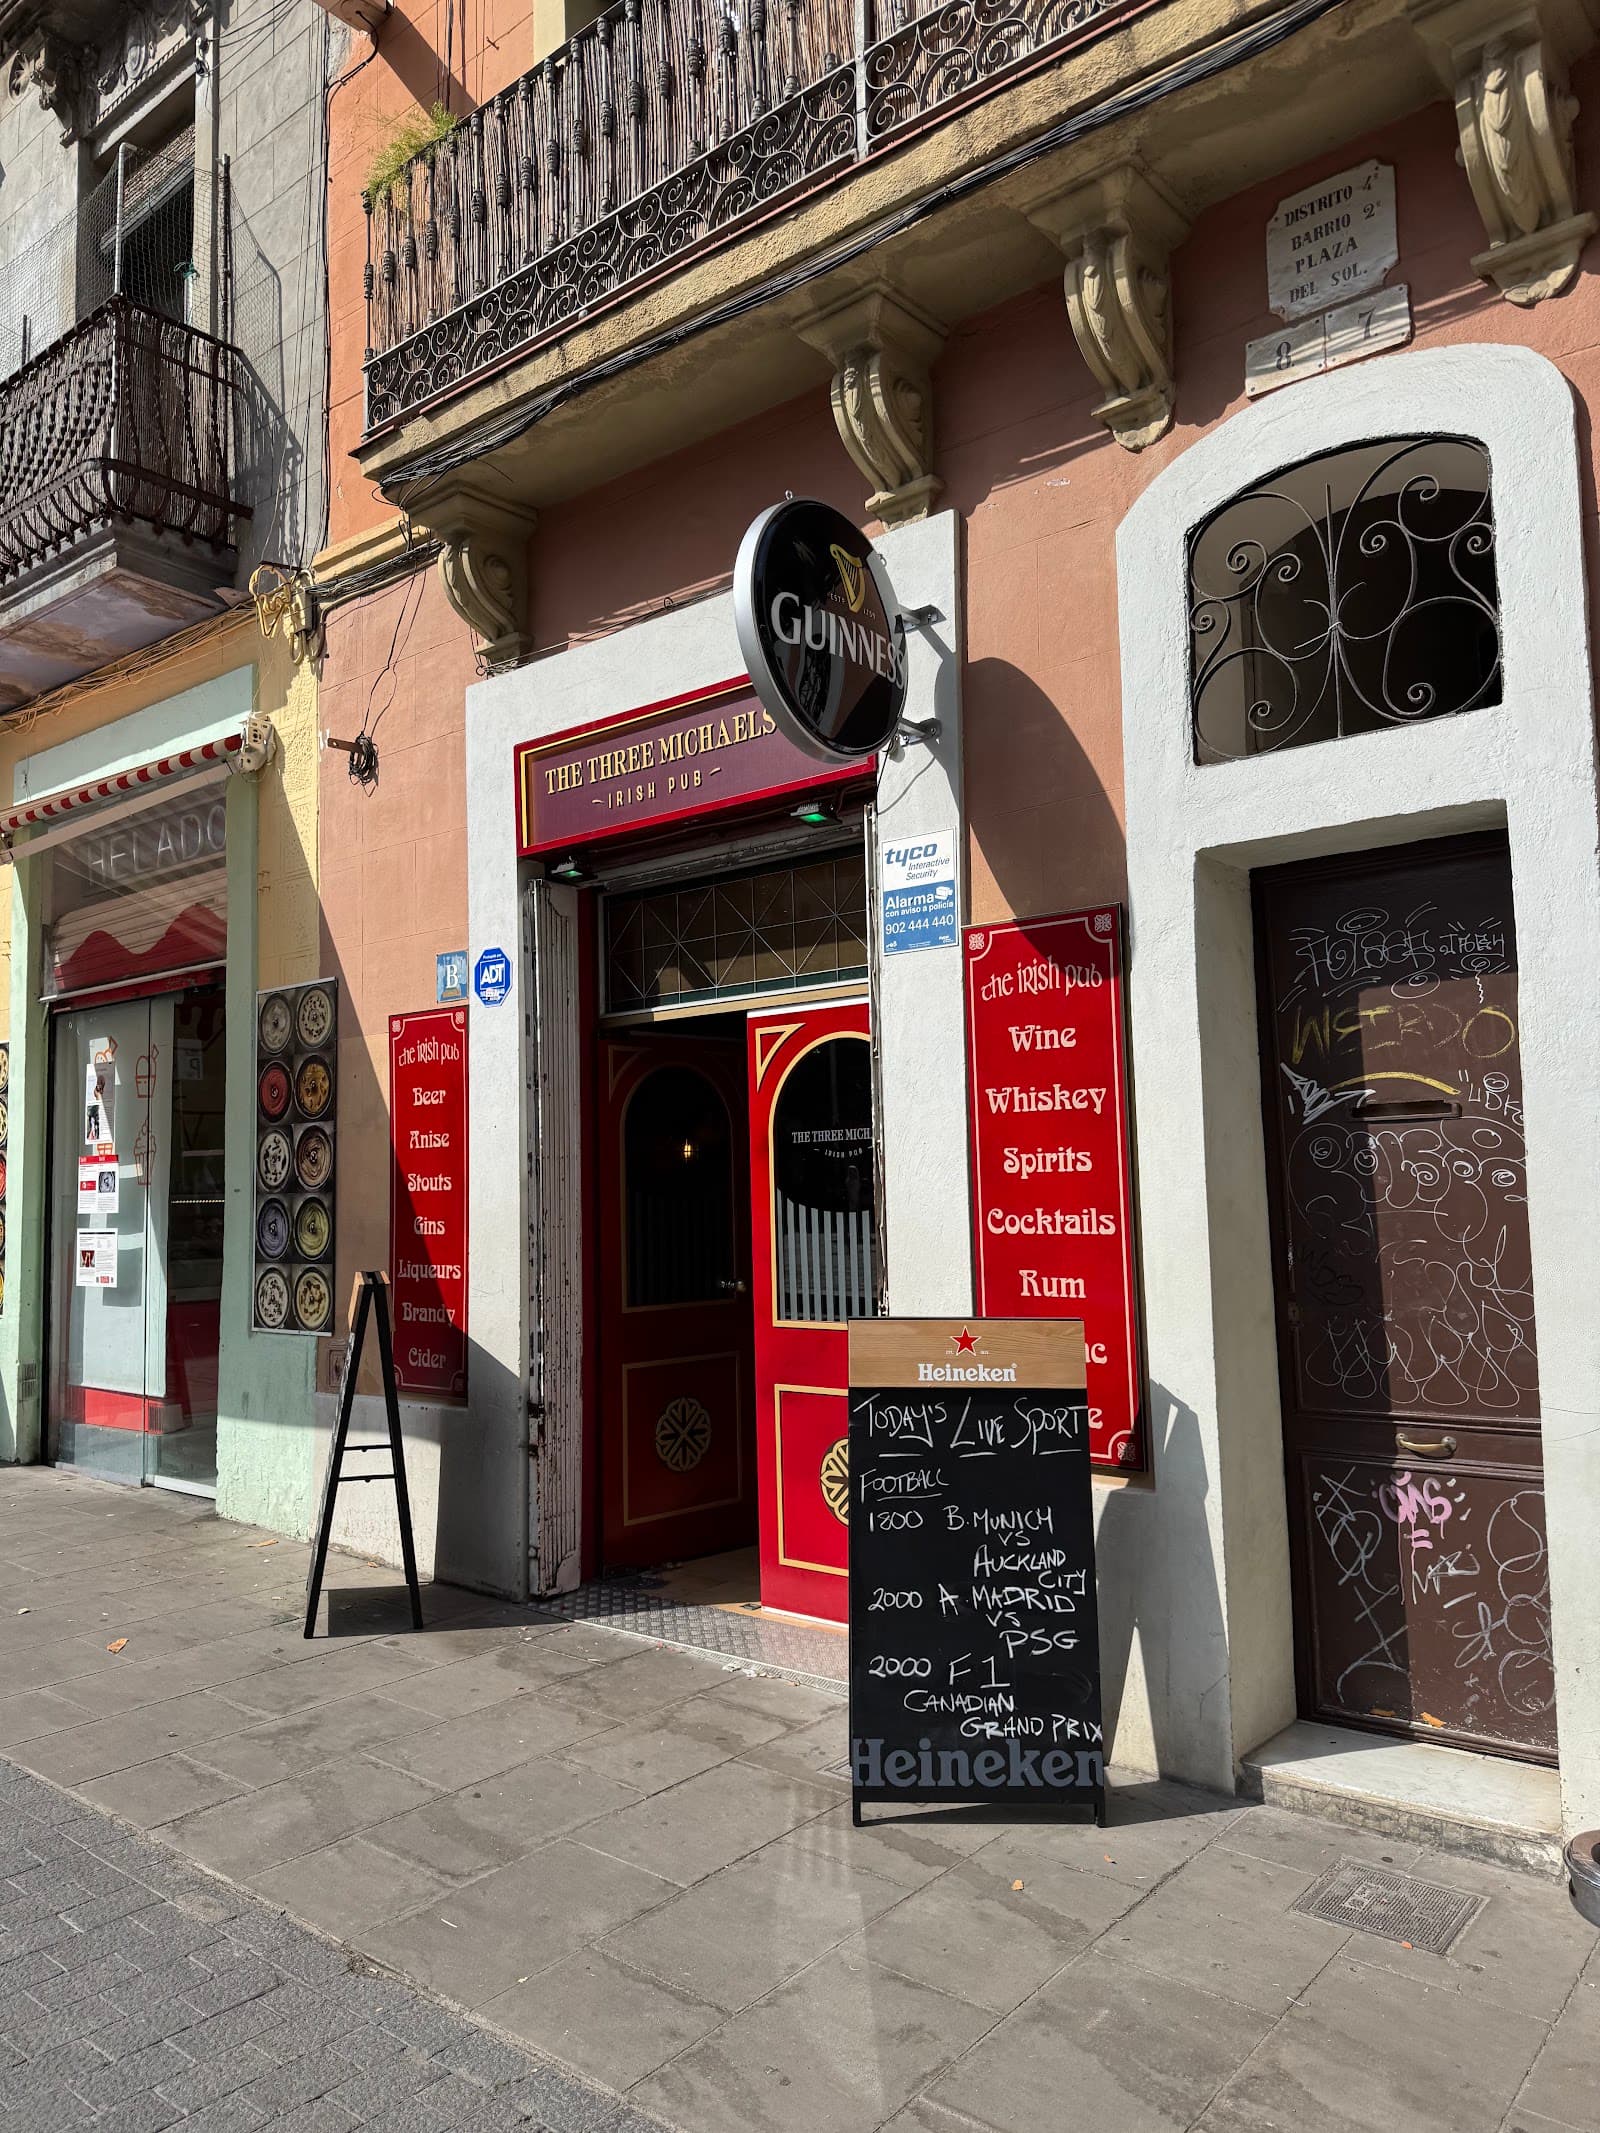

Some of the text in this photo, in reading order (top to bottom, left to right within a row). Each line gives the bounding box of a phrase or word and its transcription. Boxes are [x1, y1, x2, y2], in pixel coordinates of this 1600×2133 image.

[1284, 185, 1353, 227] DISTRITO
[1291, 213, 1351, 252] BARRIO
[1294, 236, 1358, 274] PLAZA
[1288, 281, 1318, 303] DEL
[770, 590, 905, 691] GUINNESS
[545, 706, 778, 795] THE THREE MICHAELS
[607, 770, 703, 809] IRISH PUB
[884, 843, 938, 867] tyco
[908, 856, 950, 871] Interactive
[905, 868, 938, 881] Security
[885, 891, 934, 911] Alarma
[885, 910, 899, 918] con
[900, 906, 921, 916] aviso
[922, 904, 928, 912] a
[885, 914, 954, 935] 902 444 440
[446, 964, 459, 988] B
[480, 963, 504, 985] ADT
[981, 972, 1015, 1002] the
[1064, 962, 1103, 996] pub
[1008, 1024, 1077, 1052] Wine
[399, 1046, 416, 1066] the
[440, 1042, 460, 1065] pub
[412, 1087, 446, 1106] Beer
[985, 1083, 1107, 1115] Whiskey
[409, 1130, 450, 1149] Anise
[792, 1127, 872, 1144] THE THREE MICH
[1003, 1146, 1093, 1179] Spirits
[407, 1173, 452, 1192] Stouts
[413, 1216, 446, 1235] Gins
[987, 1207, 1116, 1235] Cocktails
[397, 1259, 462, 1283] Liqueurs
[1018, 1269, 1087, 1298] Rum
[402, 1302, 455, 1326] Brandy
[408, 1347, 447, 1369] Cider
[853, 1393, 948, 1448] TODAY'S
[950, 1396, 1005, 1448] LIVE
[1010, 1397, 1089, 1456] SPORT
[859, 1468, 950, 1504] FOOTBALL
[869, 1510, 924, 1532] 1800
[973, 1544, 1067, 1578] AUCKLAND
[1038, 1569, 1087, 1596] CITY
[868, 1587, 923, 1612] 2000
[999, 1628, 1081, 1659] PSG
[868, 1655, 932, 1678] 2000
[903, 1689, 1016, 1717] CANADIAN
[960, 1713, 1103, 1743] GRAND PRIX
[852, 1737, 1104, 1788] Heineken
